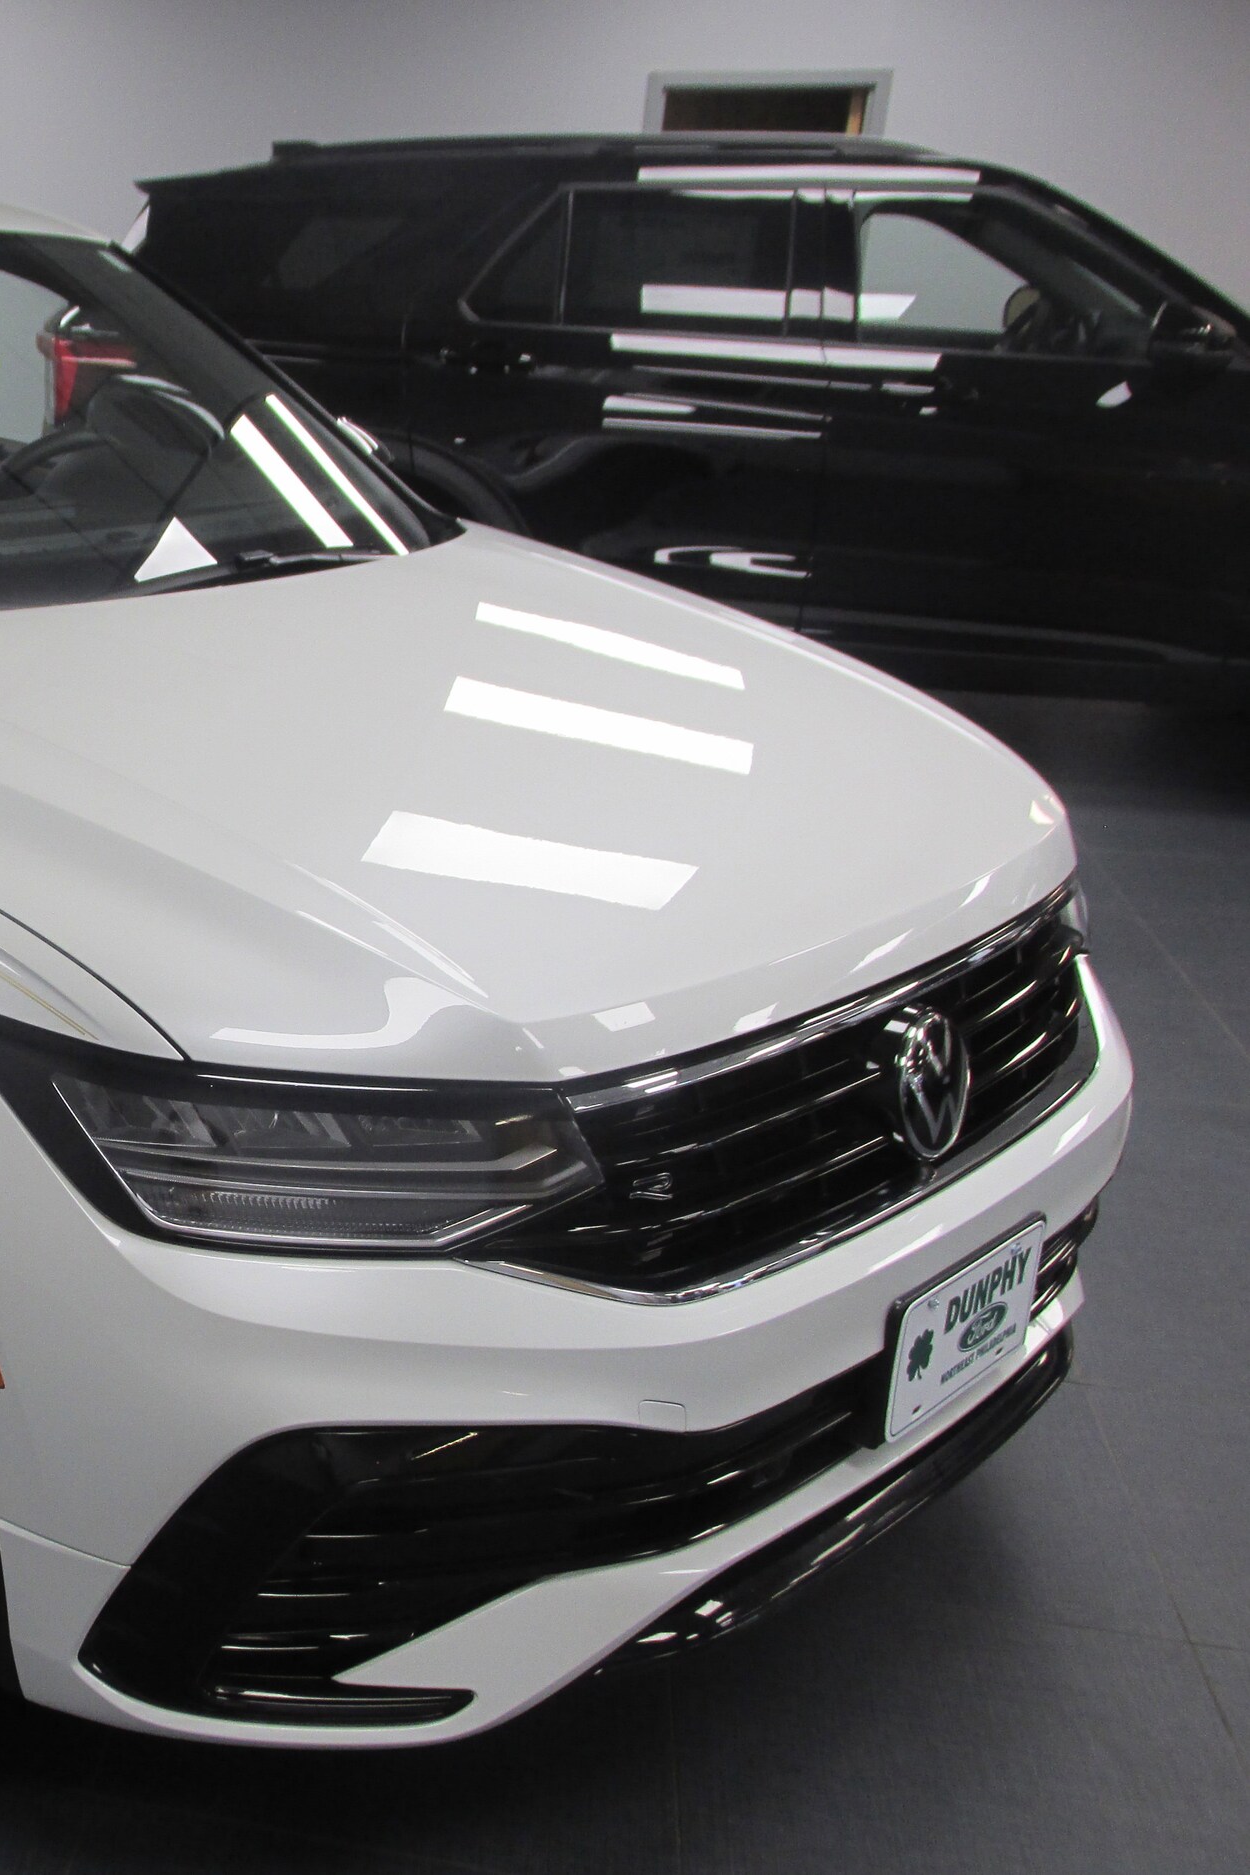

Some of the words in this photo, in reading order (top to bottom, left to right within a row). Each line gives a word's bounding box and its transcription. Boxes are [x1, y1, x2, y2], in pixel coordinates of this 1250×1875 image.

[943, 1246, 1032, 1335] DUNPHY
[940, 1350, 975, 1386] NORTHEAST
[975, 1322, 1017, 1361] PHILADELPHIA
